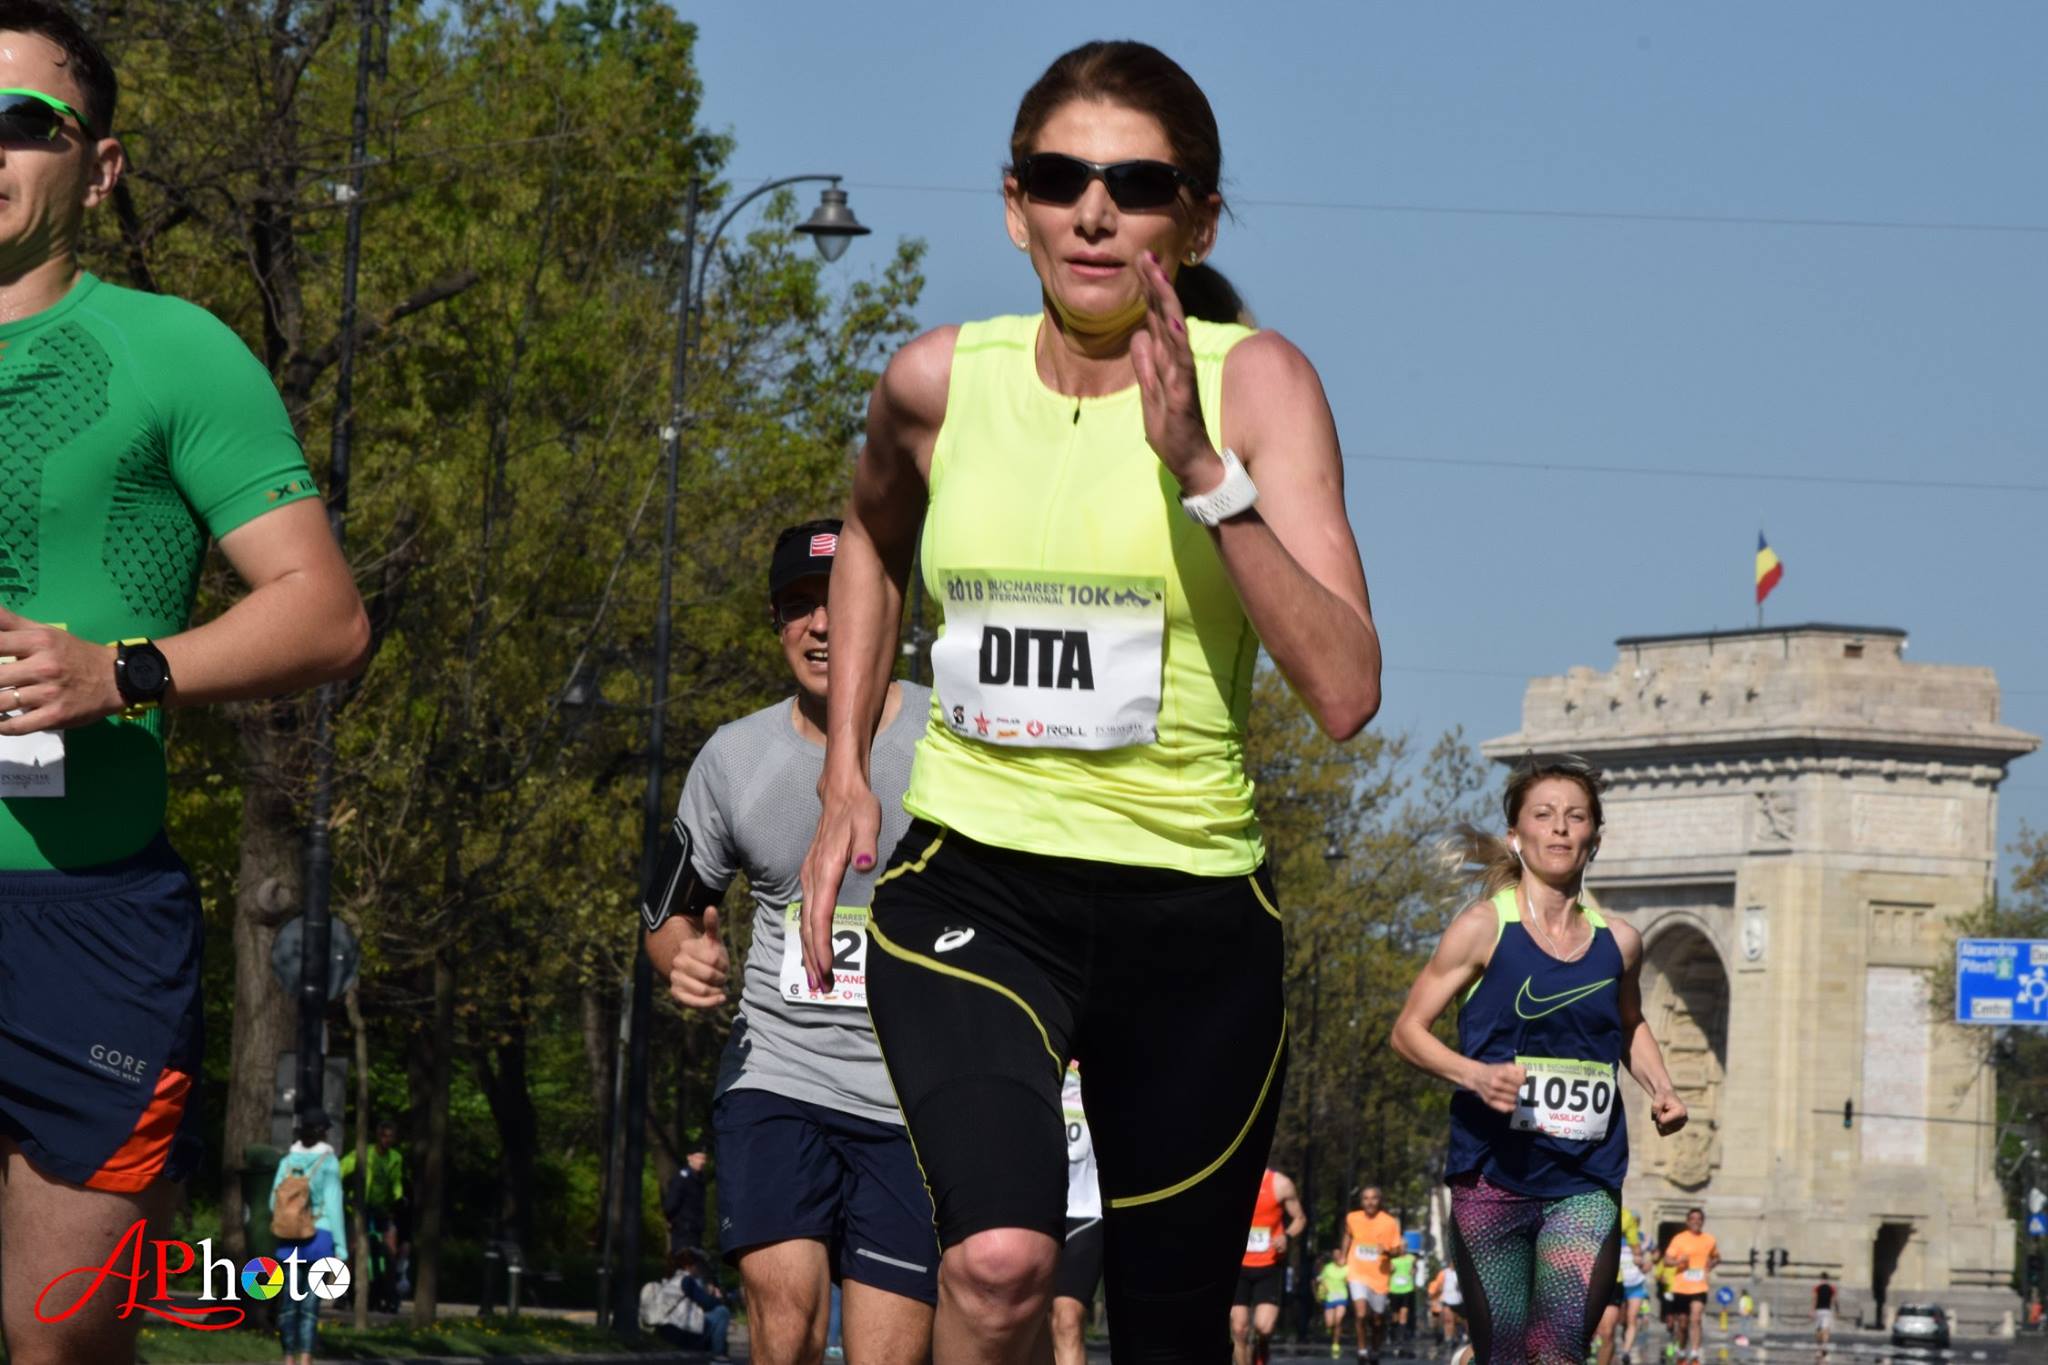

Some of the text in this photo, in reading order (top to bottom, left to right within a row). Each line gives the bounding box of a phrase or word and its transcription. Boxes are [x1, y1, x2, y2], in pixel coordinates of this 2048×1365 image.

[948, 580, 983, 601] 2018
[1067, 586, 1110, 606] 10K
[979, 625, 1095, 691] DITA
[90, 1044, 147, 1075] GORE
[1521, 1075, 1610, 1114] 1050
[1548, 1113, 1585, 1123] VASILICA
